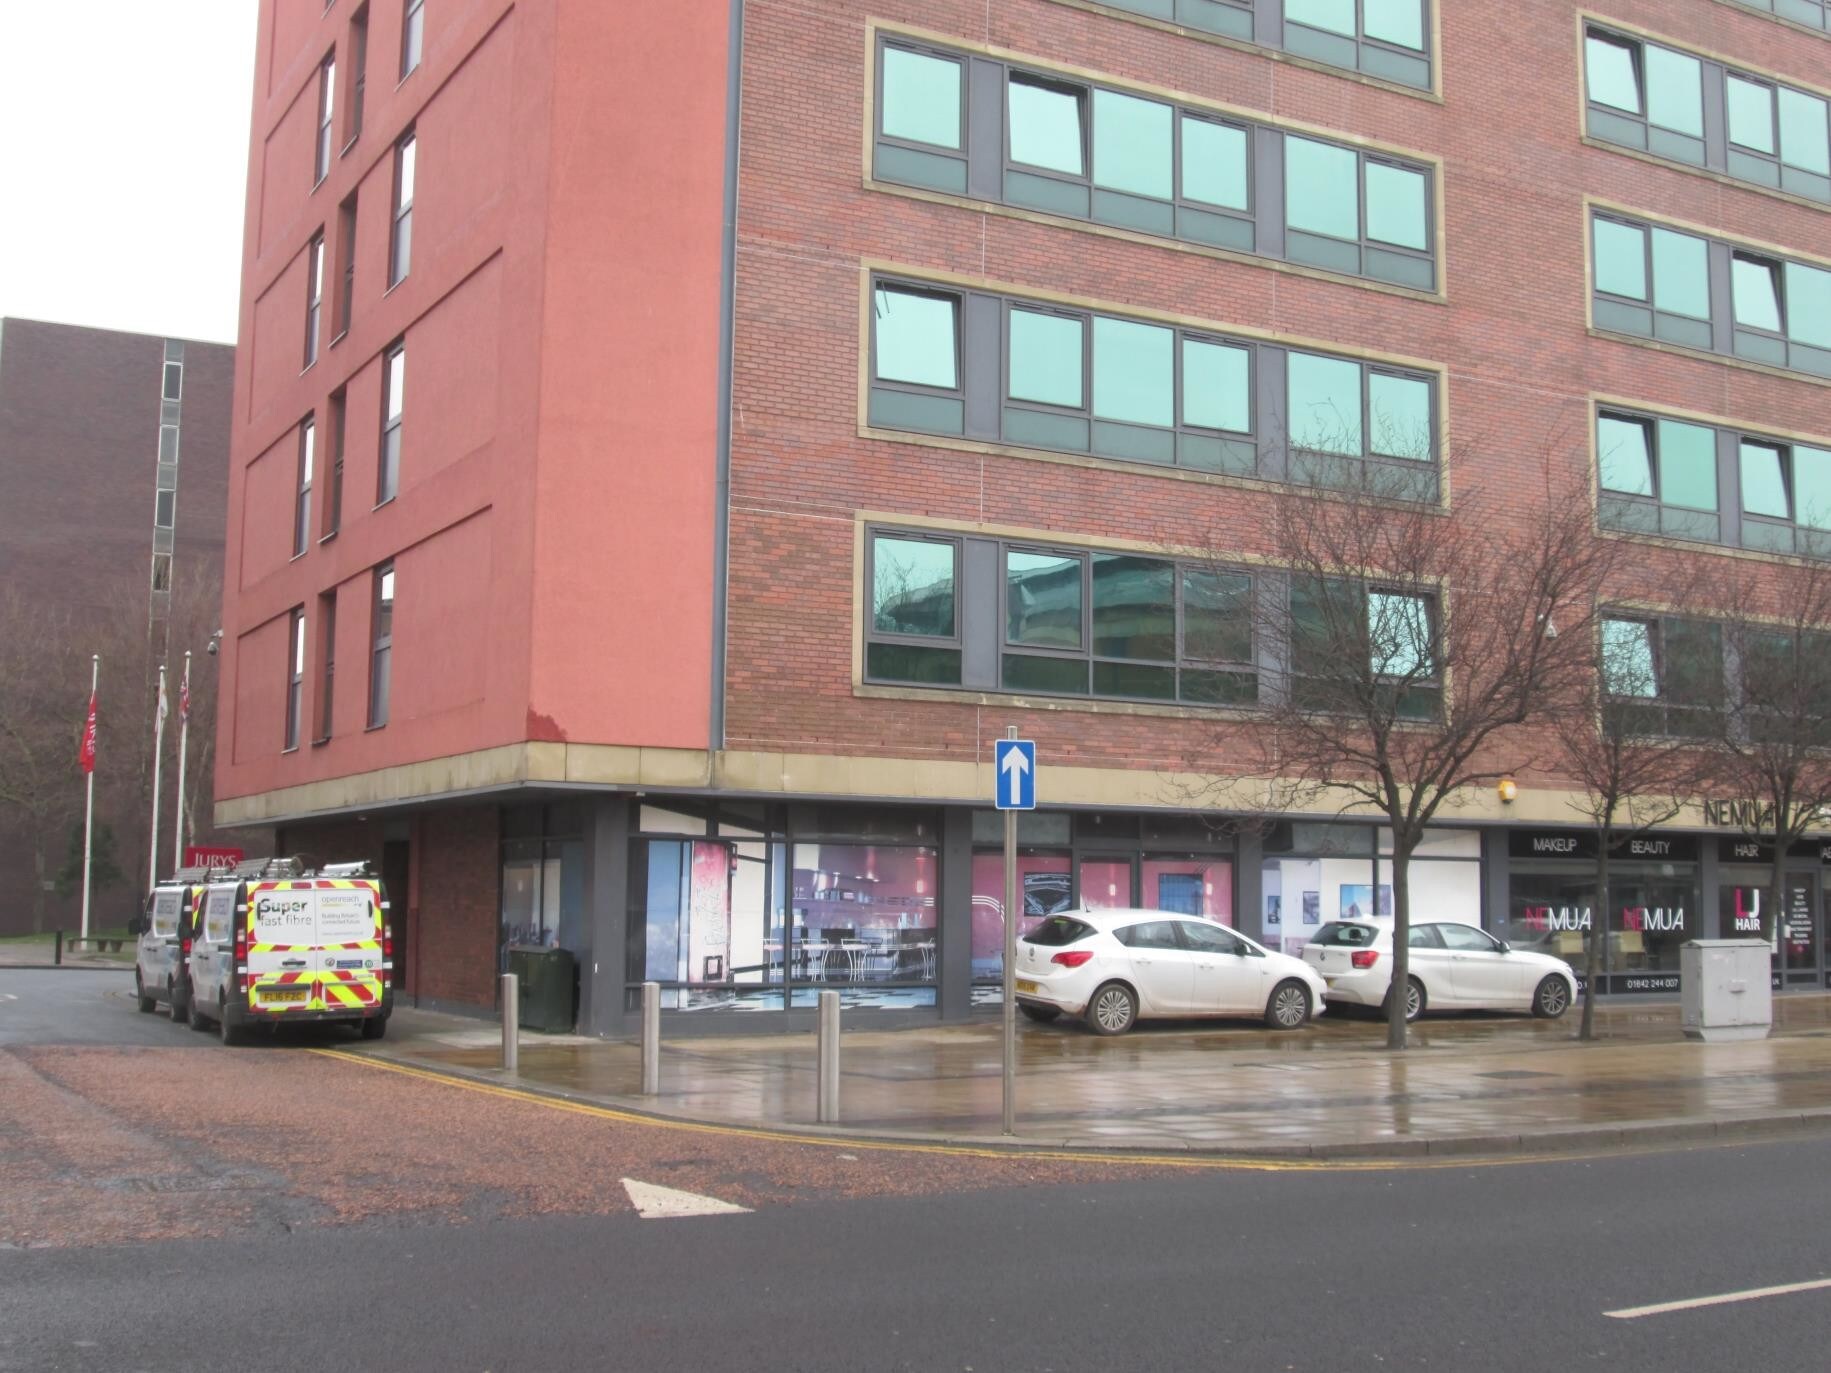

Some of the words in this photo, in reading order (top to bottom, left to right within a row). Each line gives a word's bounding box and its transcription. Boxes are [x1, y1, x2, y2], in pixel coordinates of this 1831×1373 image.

[1533, 838, 1578, 852] MAKEUP
[1631, 840, 1671, 855] BEAUTY
[1734, 843, 1760, 857] HAIR
[193, 852, 237, 868] JURYS
[259, 898, 308, 916] Super
[260, 915, 283, 927] fast
[285, 913, 312, 926] fibre
[1524, 907, 1592, 931] NEMUA
[1623, 906, 1684, 931] NEMUA
[1735, 918, 1761, 931] HAIR
